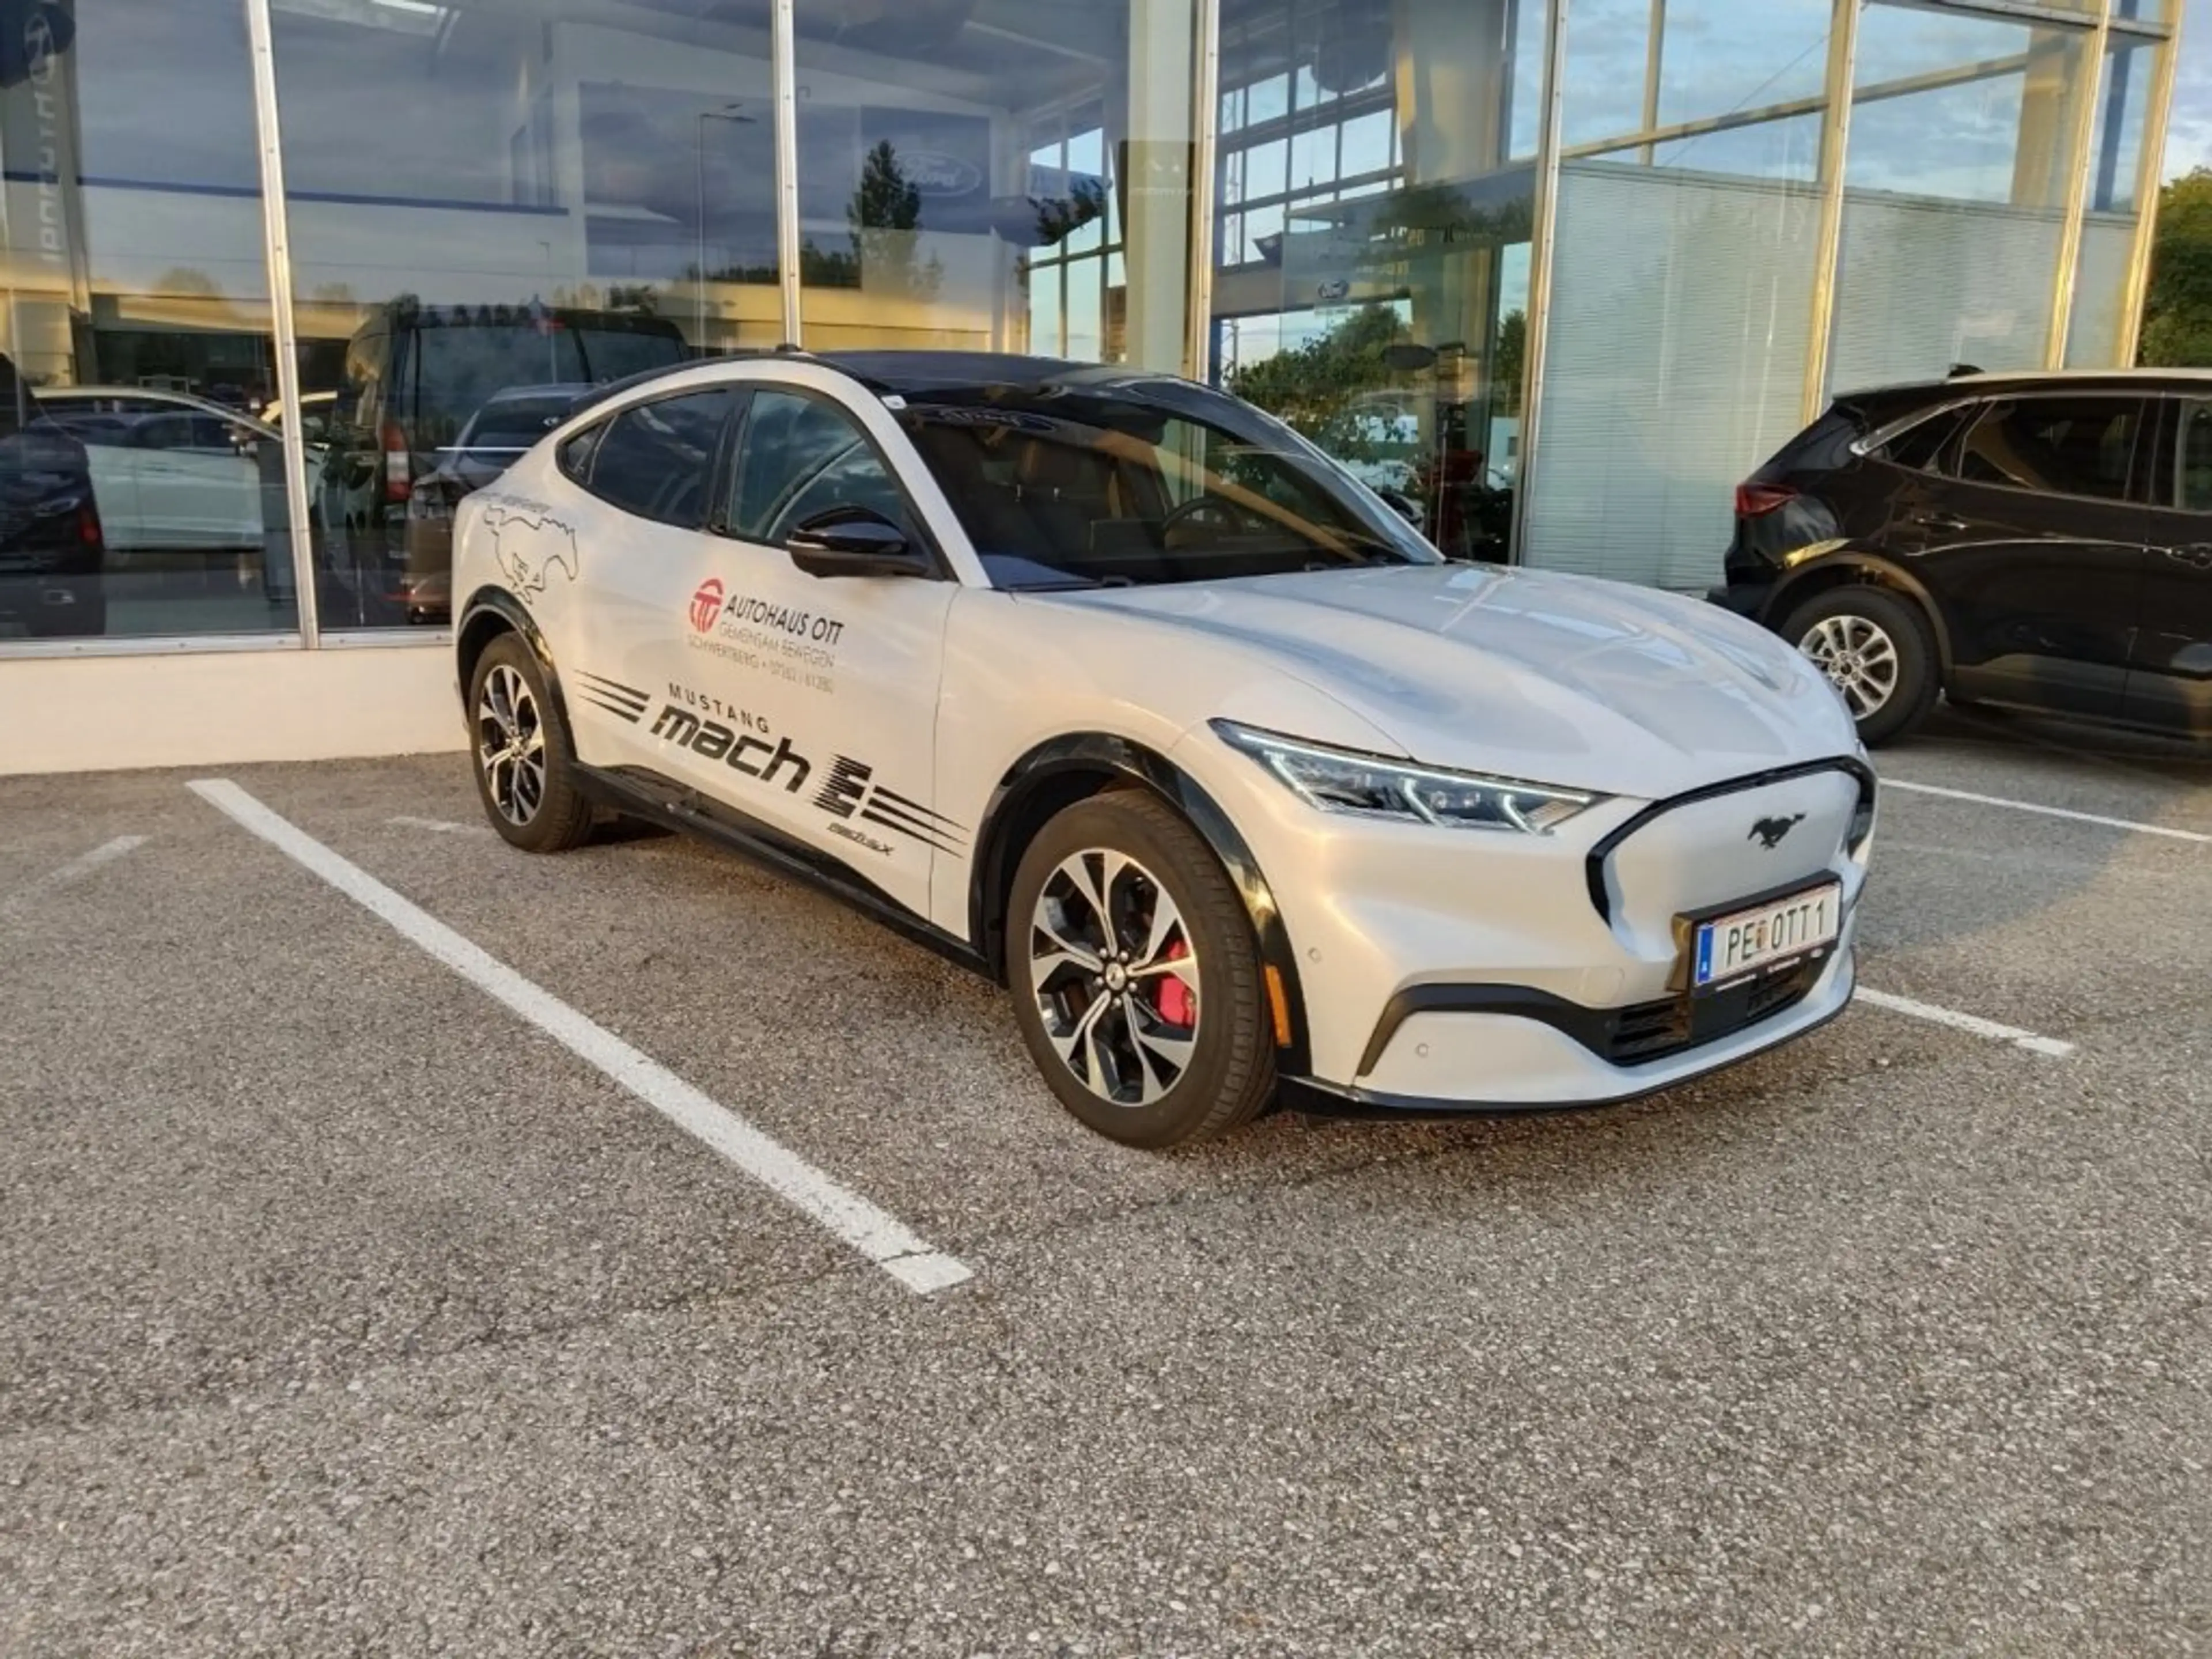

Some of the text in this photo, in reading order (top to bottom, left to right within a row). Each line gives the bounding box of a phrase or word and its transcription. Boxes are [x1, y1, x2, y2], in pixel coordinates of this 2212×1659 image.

[724, 594, 844, 645] AUTOHAUS OTT
[668, 682, 769, 734] MUSTANG
[650, 704, 811, 794] mach
[1727, 922, 1755, 965] PE
[1771, 905, 1810, 949] OTT
